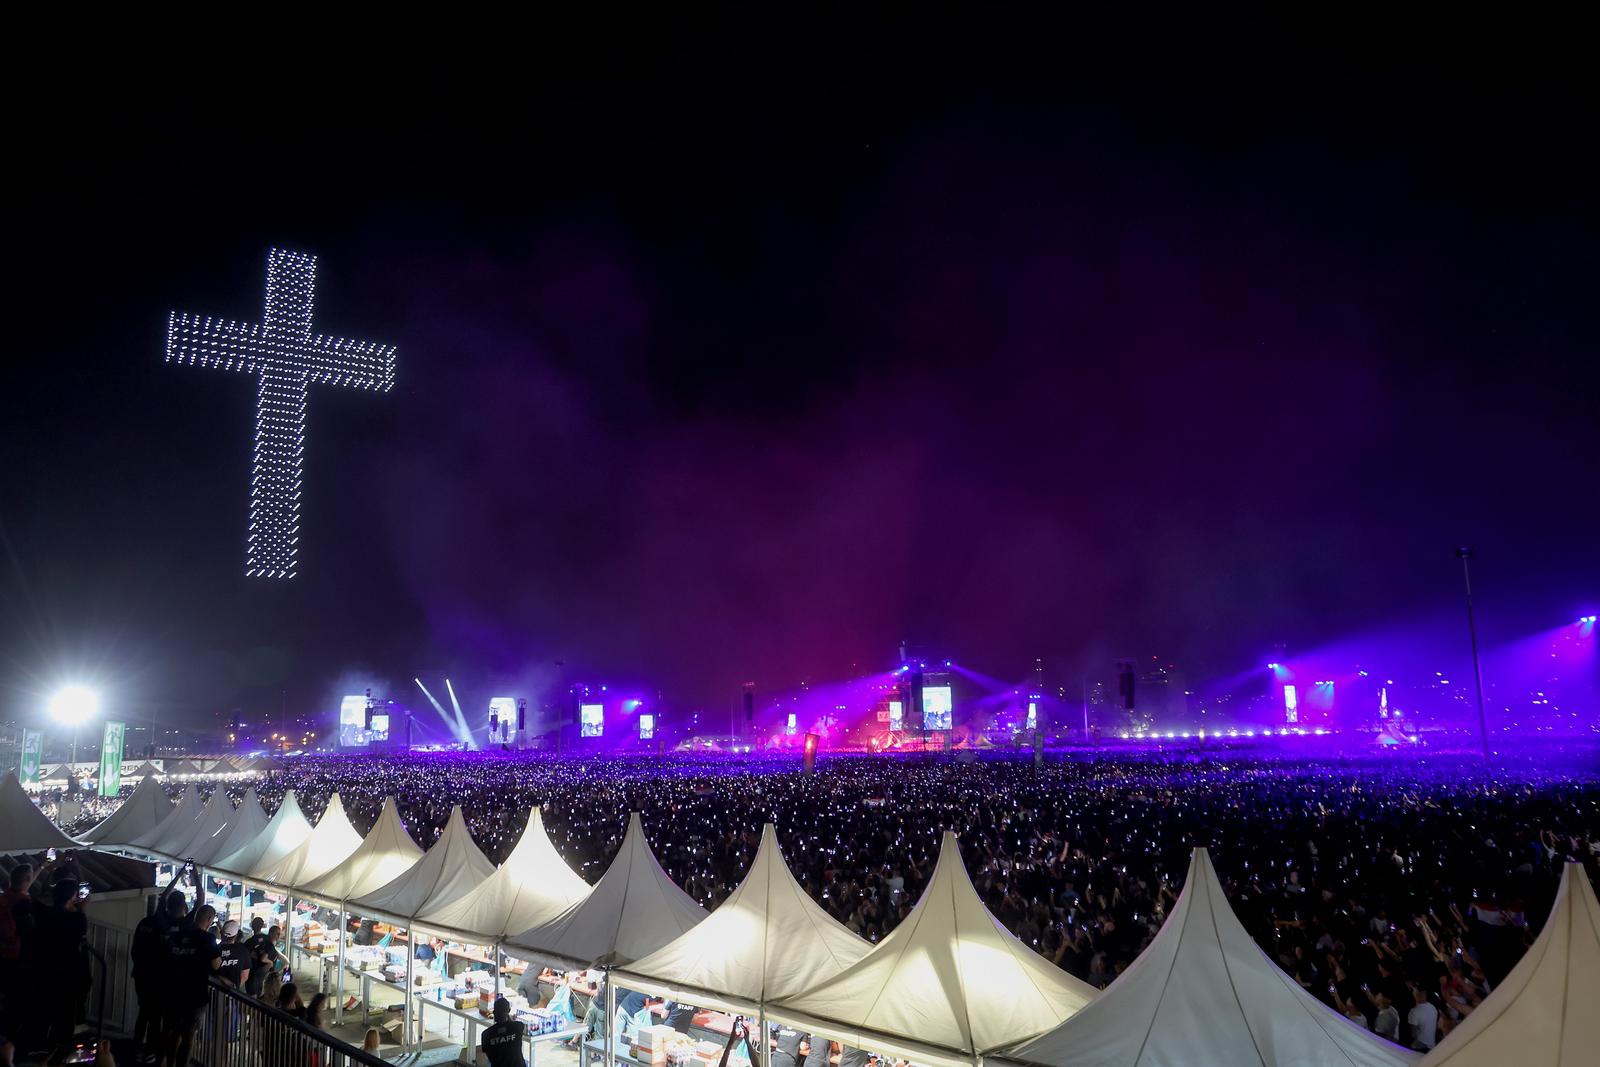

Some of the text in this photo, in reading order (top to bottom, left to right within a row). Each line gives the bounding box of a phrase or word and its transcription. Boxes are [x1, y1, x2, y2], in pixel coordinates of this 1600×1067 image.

[220, 959, 239, 967] AFF
[677, 1003, 694, 1011] STAFF
[490, 1034, 516, 1046] STAFF
